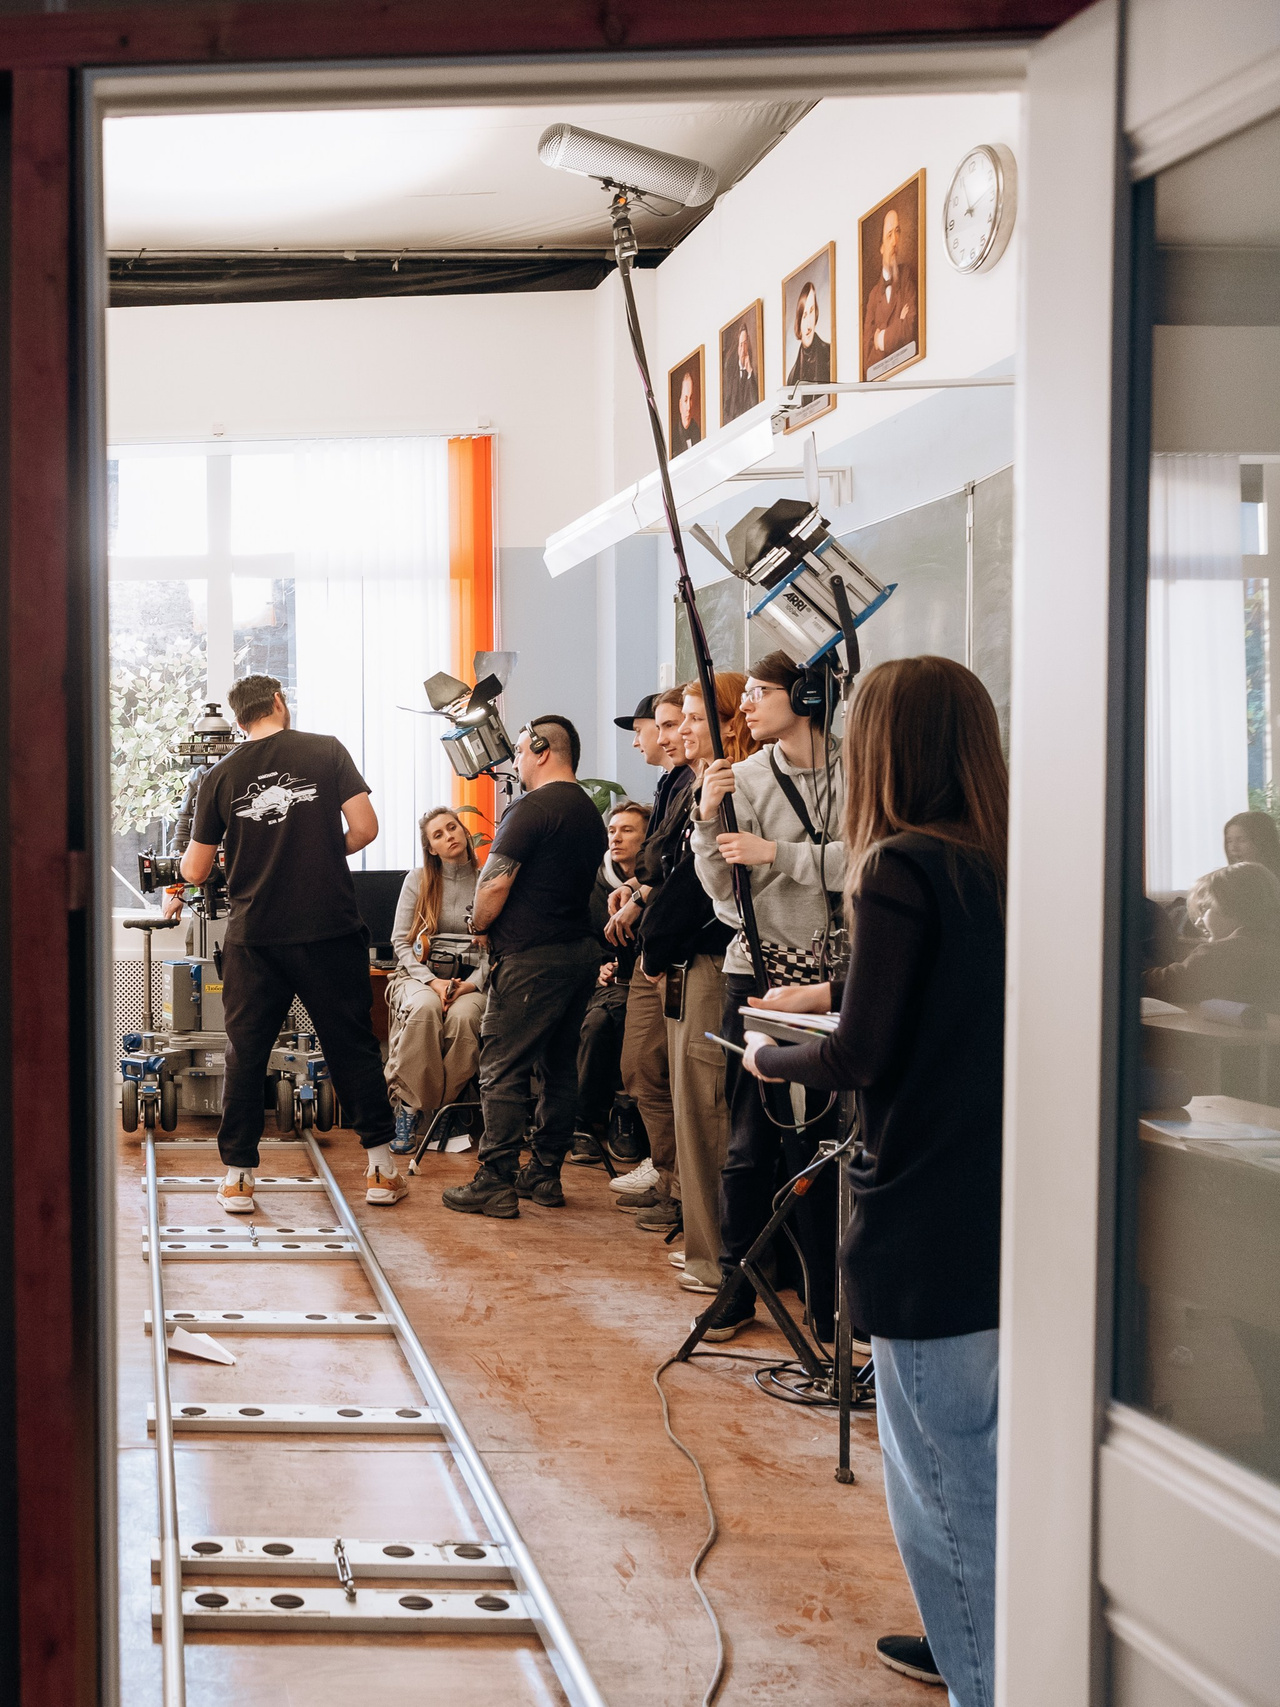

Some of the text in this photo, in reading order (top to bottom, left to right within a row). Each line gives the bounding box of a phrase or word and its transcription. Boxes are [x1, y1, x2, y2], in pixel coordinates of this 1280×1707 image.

[968, 161, 976, 174] 12
[987, 169, 993, 181] 2
[952, 196, 960, 208] 10
[987, 212, 993, 223] 4
[949, 219, 955, 231] 9
[953, 238, 959, 250] 8
[980, 234, 986, 247] 5
[960, 248, 966, 260] 7
[970, 248, 976, 260] 6
[783, 593, 807, 612] ARRI
